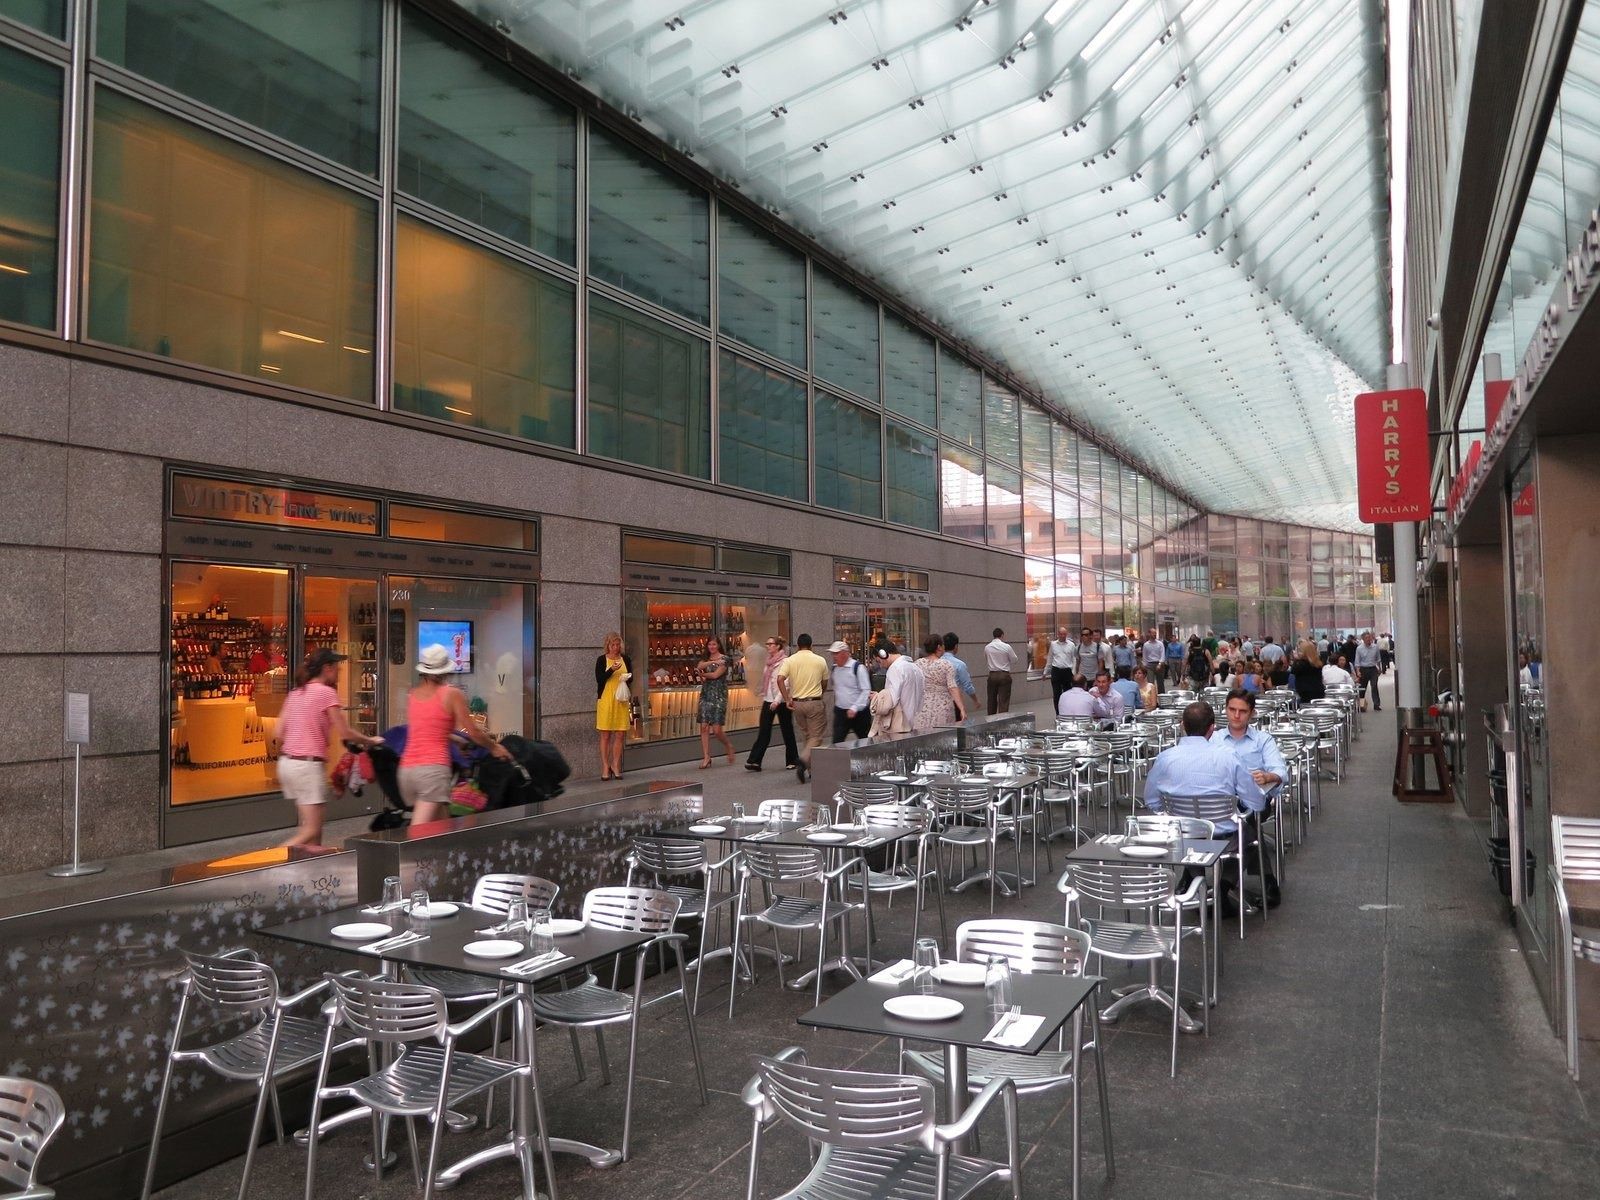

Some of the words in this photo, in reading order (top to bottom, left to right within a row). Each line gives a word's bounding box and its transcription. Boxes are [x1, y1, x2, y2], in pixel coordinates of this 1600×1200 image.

[1382, 398, 1400, 495] HARRYS
[287, 503, 321, 520] FINE
[330, 508, 376, 526] WINES
[1370, 505, 1419, 515] ITALIAN
[392, 589, 410, 602] 230
[190, 759, 237, 771] CALIFORNIA
